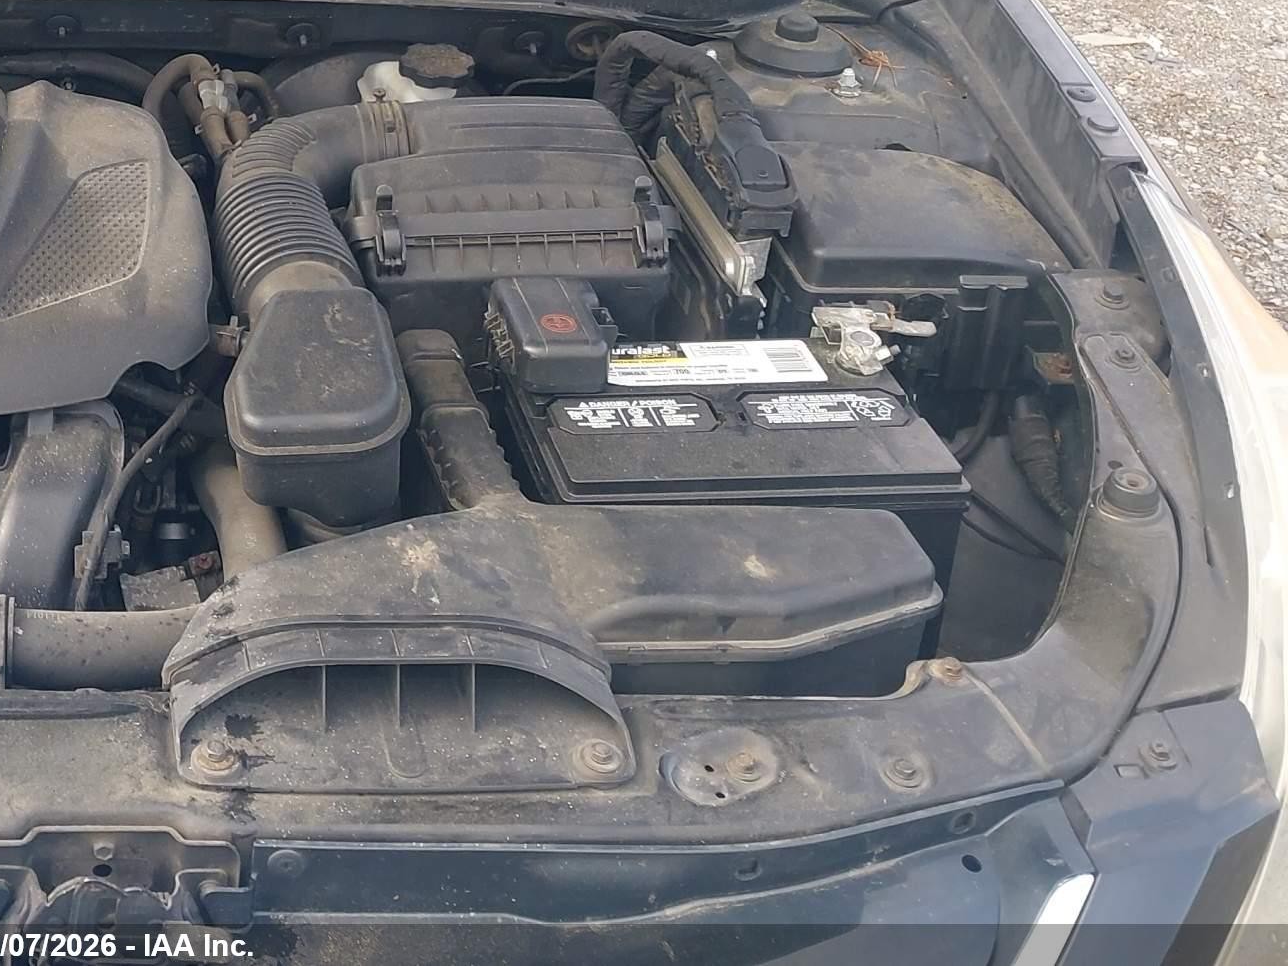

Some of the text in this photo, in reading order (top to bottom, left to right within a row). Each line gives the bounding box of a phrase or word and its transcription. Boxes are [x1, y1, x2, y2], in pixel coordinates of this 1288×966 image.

[611, 345, 671, 356] uralast
[588, 400, 630, 408] DANGER
[638, 398, 677, 406] POISON
